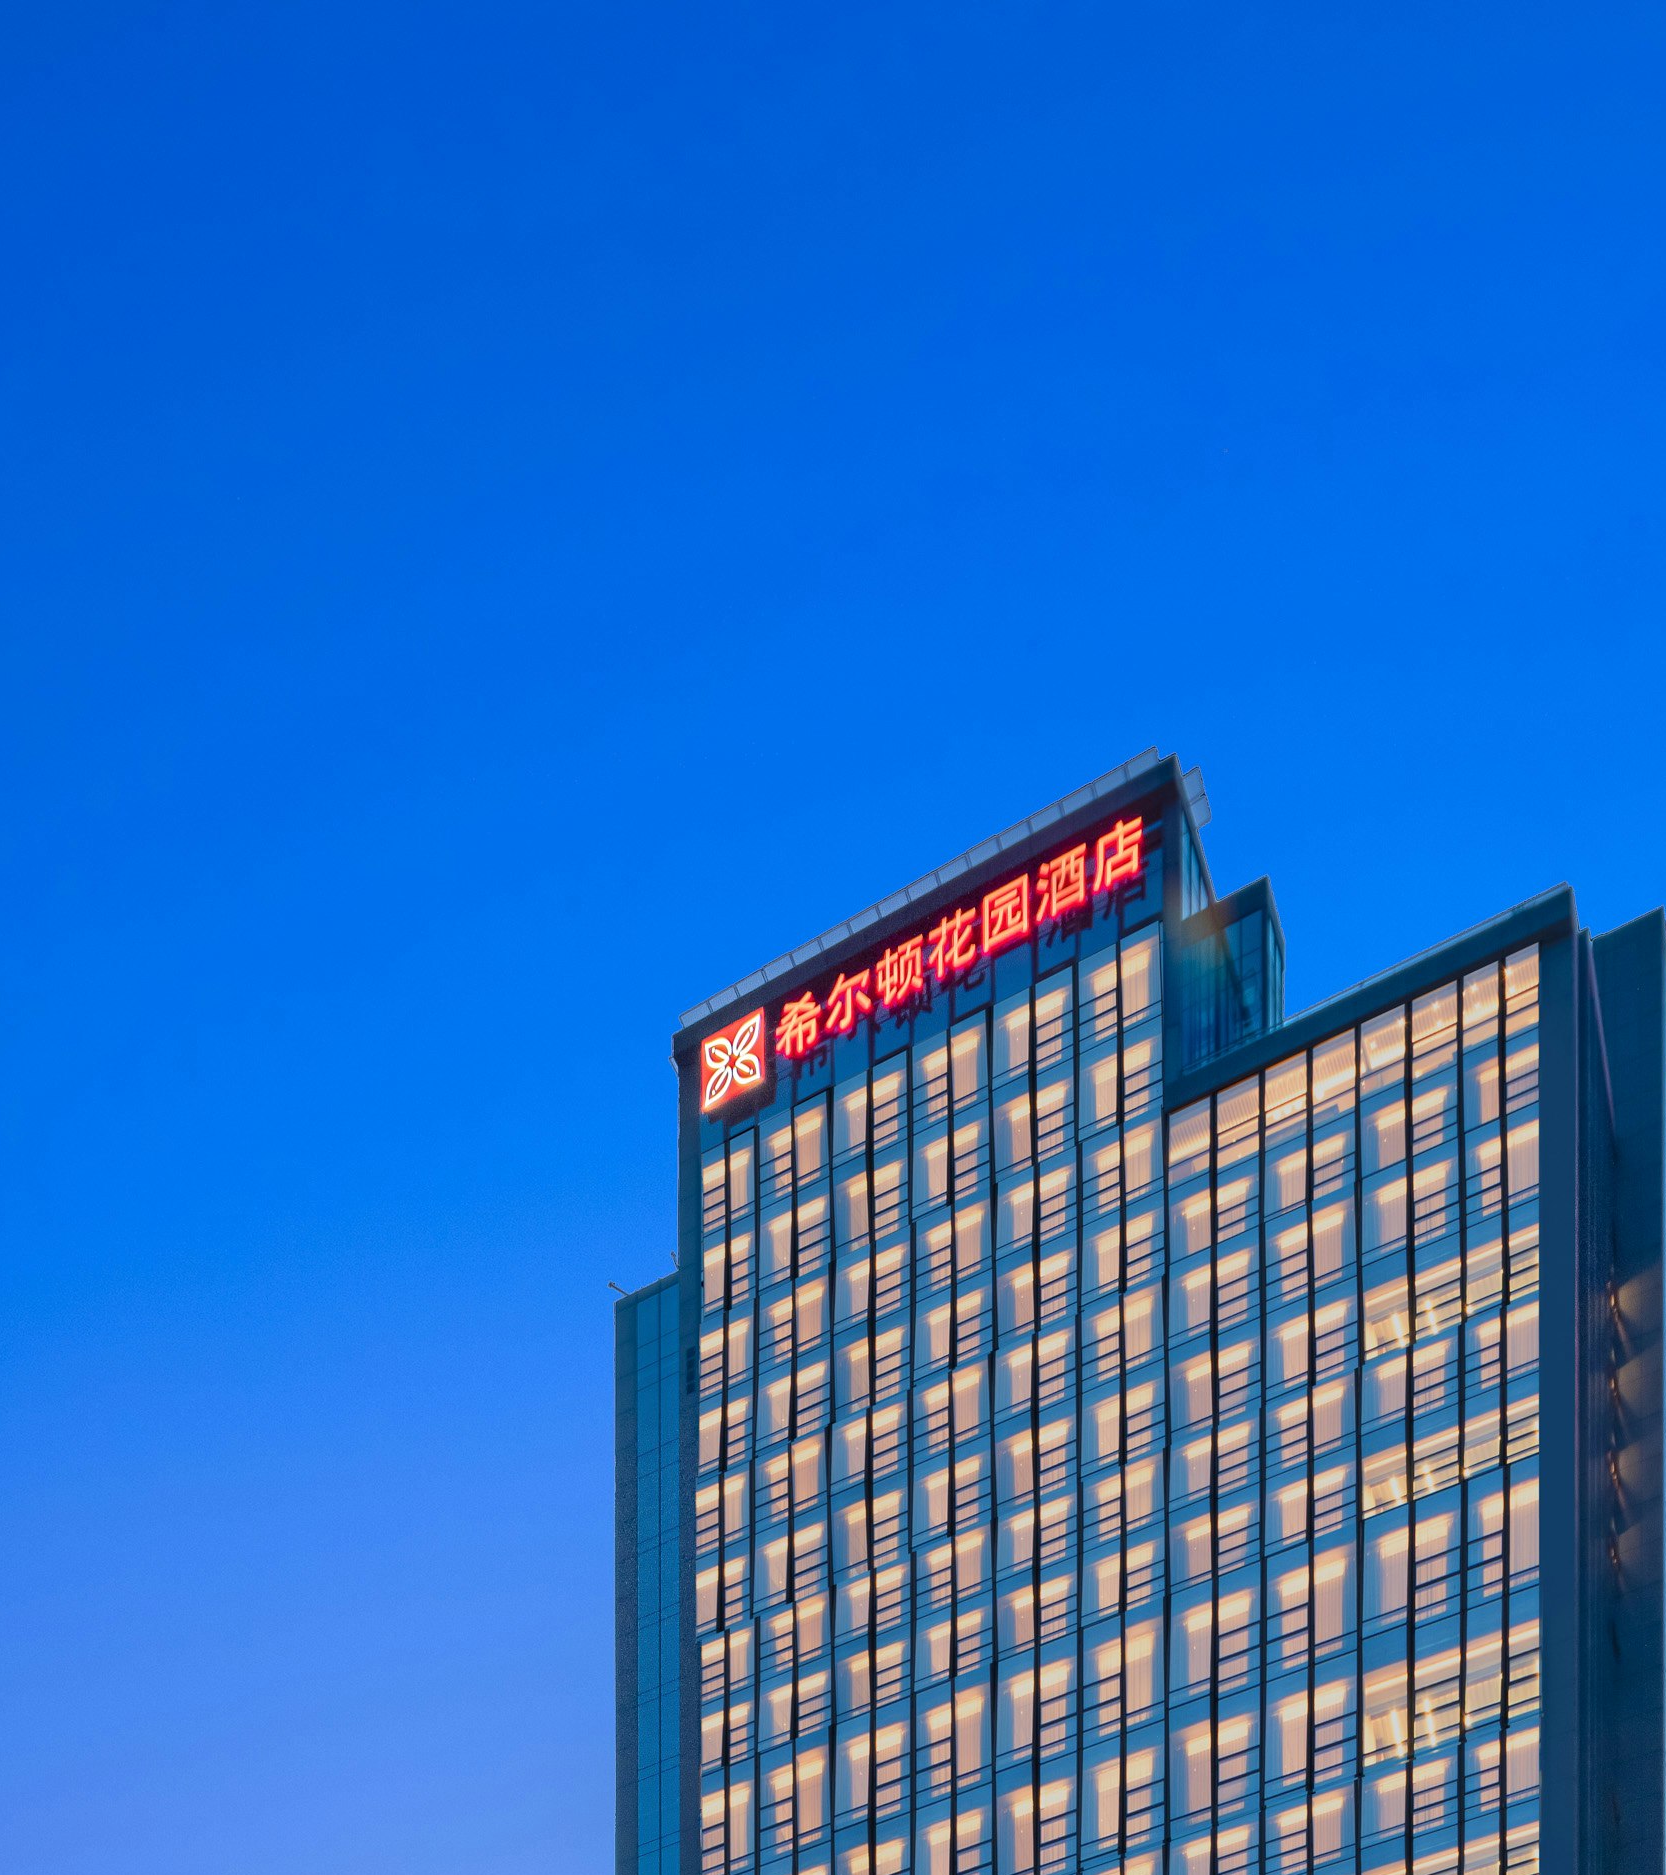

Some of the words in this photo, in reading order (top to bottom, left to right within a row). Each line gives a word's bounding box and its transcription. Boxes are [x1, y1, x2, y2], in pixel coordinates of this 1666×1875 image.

[775, 815, 1144, 1058] 希尔顿花园酒店
